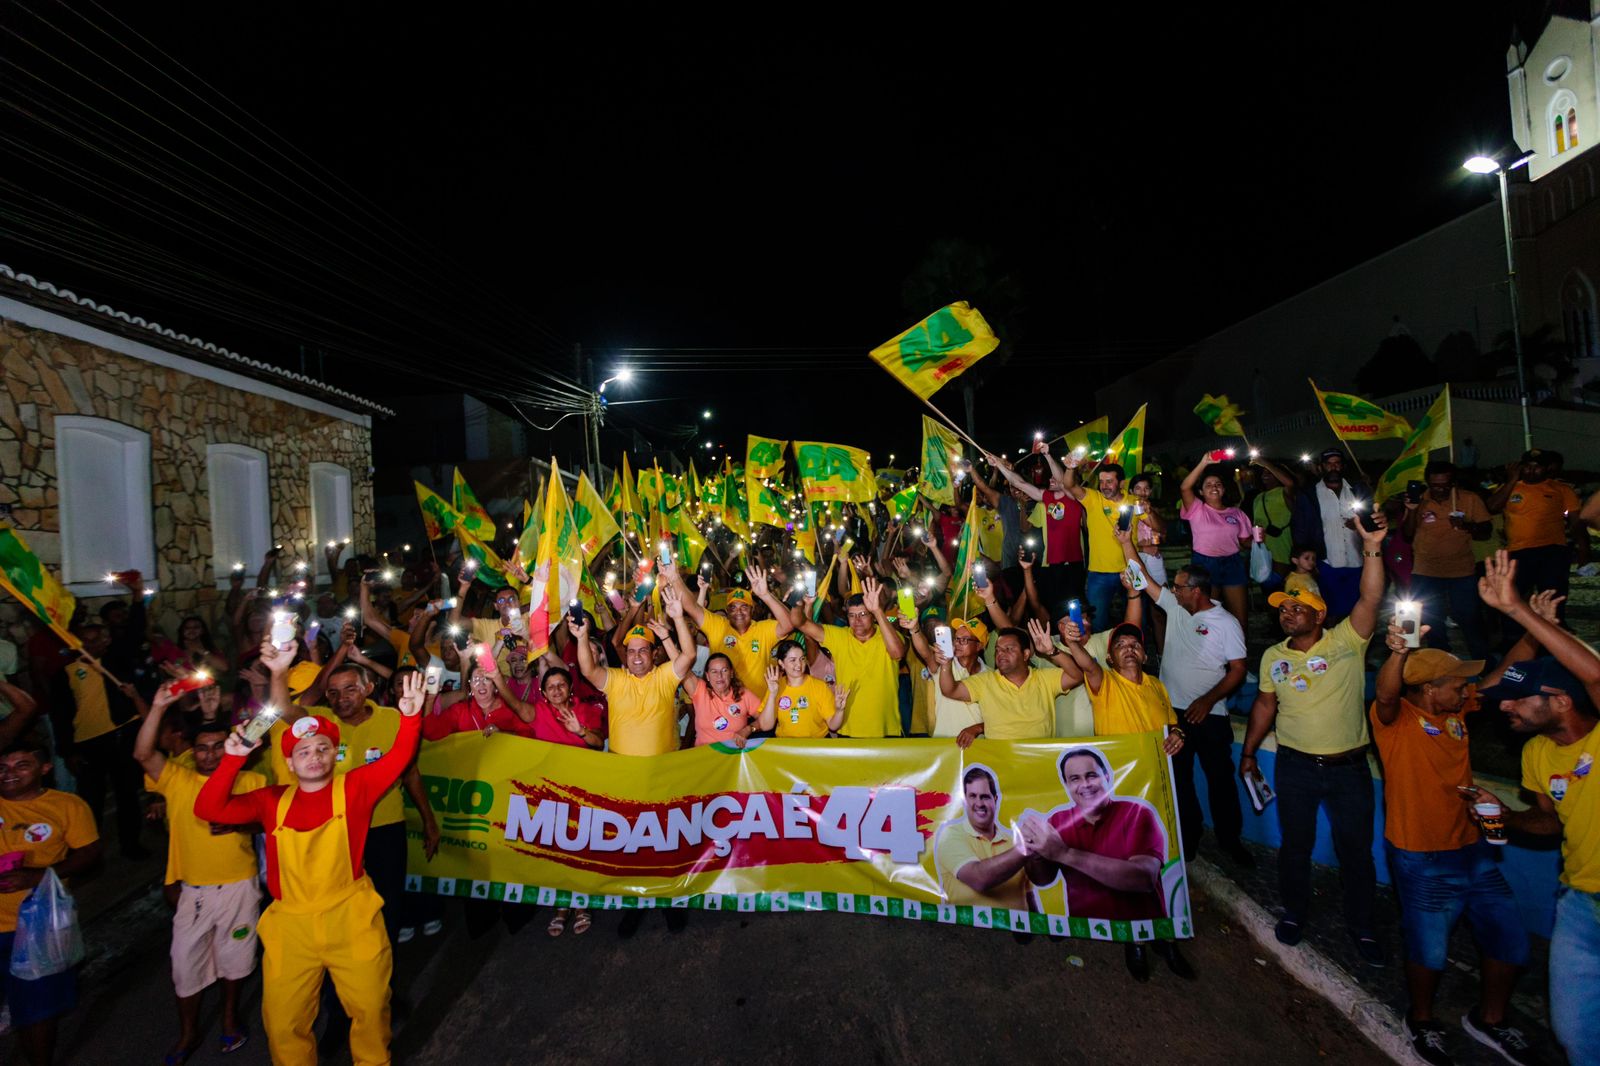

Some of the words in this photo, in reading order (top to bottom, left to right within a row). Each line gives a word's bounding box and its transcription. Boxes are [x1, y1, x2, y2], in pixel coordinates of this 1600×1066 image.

[899, 306, 975, 373] 44
[1338, 424, 1379, 433] MARIO
[798, 445, 859, 482] 44
[504, 793, 779, 857] MUDANÇA
[782, 782, 813, 840] É
[816, 784, 926, 864] 44
